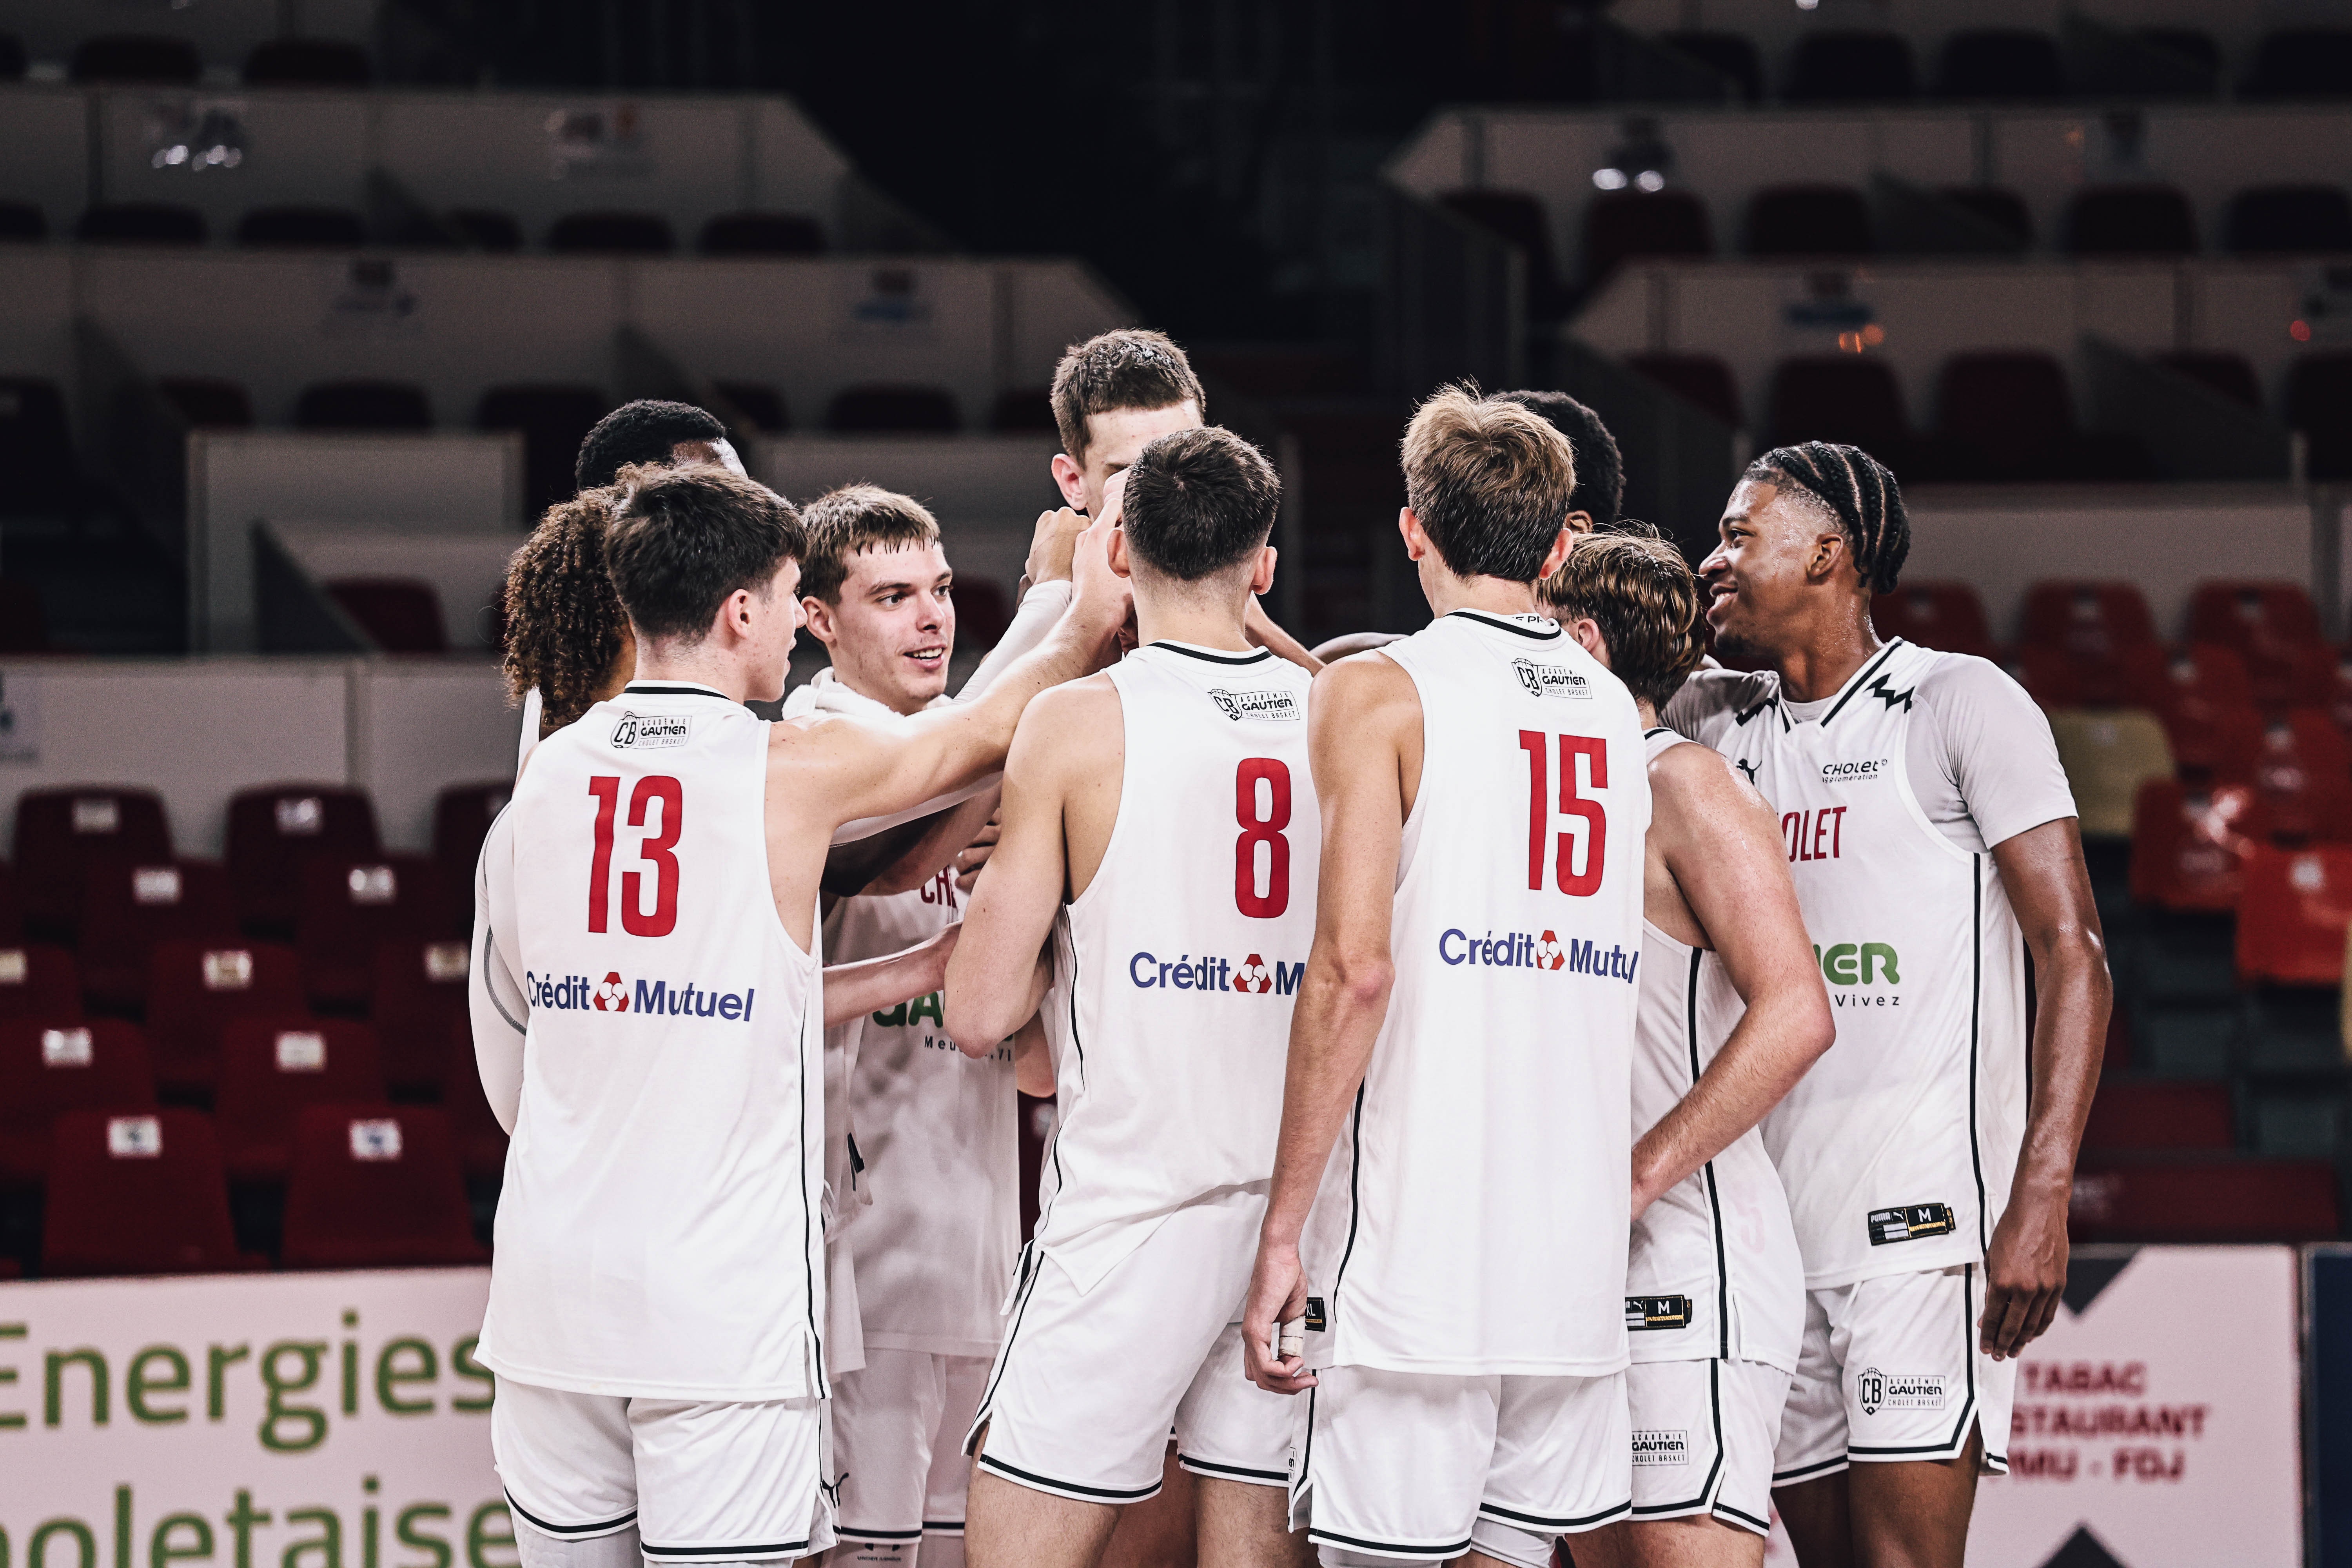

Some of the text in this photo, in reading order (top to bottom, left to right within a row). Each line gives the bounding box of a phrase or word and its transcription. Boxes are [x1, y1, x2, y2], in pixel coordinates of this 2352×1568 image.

[1517, 666, 1539, 690] CB
[1542, 675, 1586, 685] GAUTIER
[1213, 696, 1240, 714] CB
[1241, 693, 1289, 702] ACADÉMIE
[1241, 699, 1293, 711] GAUTIER
[641, 726, 686, 736] GAUTIER
[642, 718, 686, 726] ACADÉMIE
[614, 721, 637, 744] CB
[1519, 730, 1608, 897] 15
[1235, 757, 1291, 918] 8
[1782, 806, 1847, 862] OLET
[588, 775, 683, 937] 13
[1439, 928, 1534, 968] Crédit
[1130, 952, 1230, 991] Crédit
[526, 971, 754, 1022] Crédit Mutuel
[1835, 994, 1900, 1007] Vivez
[1918, 1208, 1932, 1223] M
[1658, 1300, 1670, 1314] M
[2025, 1361, 2146, 1395] TABAC
[1862, 1378, 1882, 1404] CB
[1889, 1386, 1942, 1395] GAUTIER
[1632, 1441, 1684, 1452] GAUTIER
